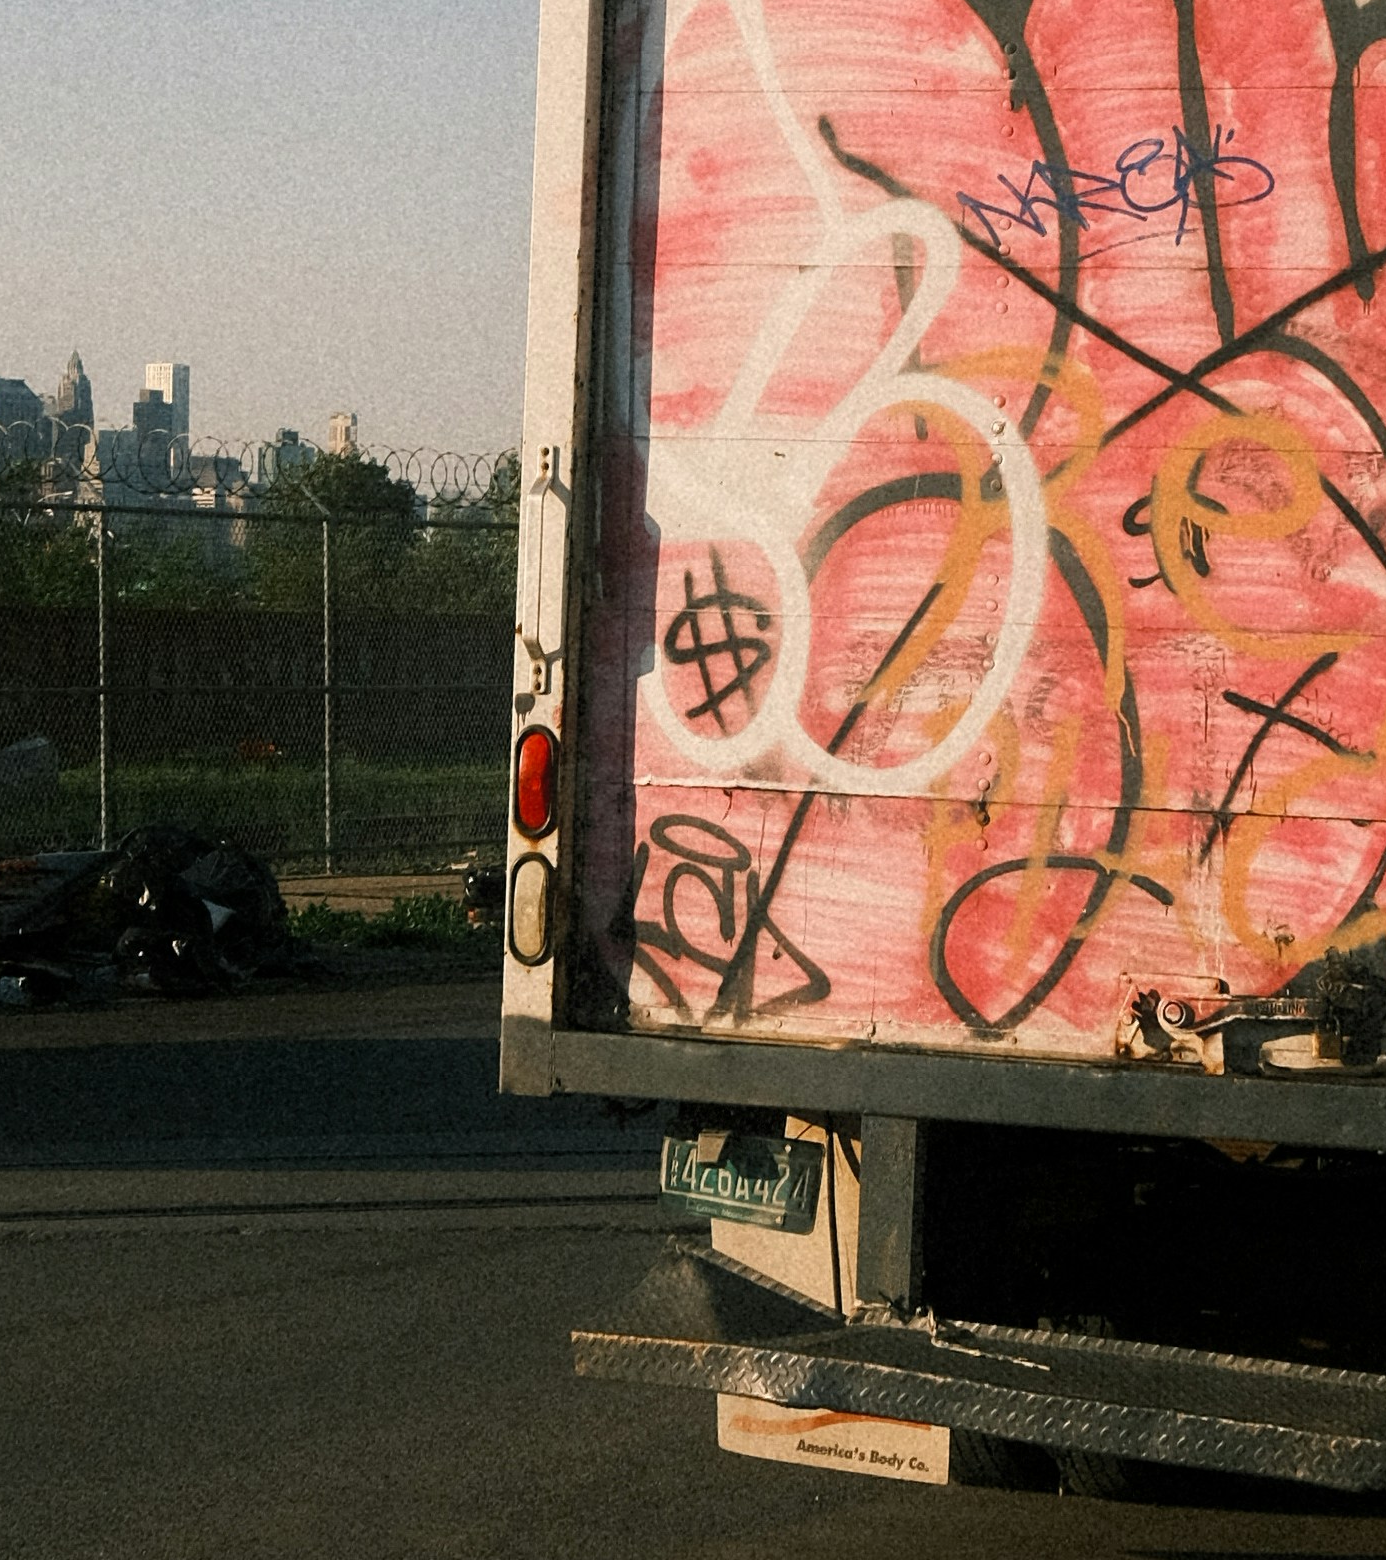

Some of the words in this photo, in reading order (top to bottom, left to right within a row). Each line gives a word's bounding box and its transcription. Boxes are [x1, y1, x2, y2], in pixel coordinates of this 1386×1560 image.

[796, 1439, 866, 1462] America's
[869, 1450, 905, 1471] Body
[909, 1457, 930, 1472] Co.
